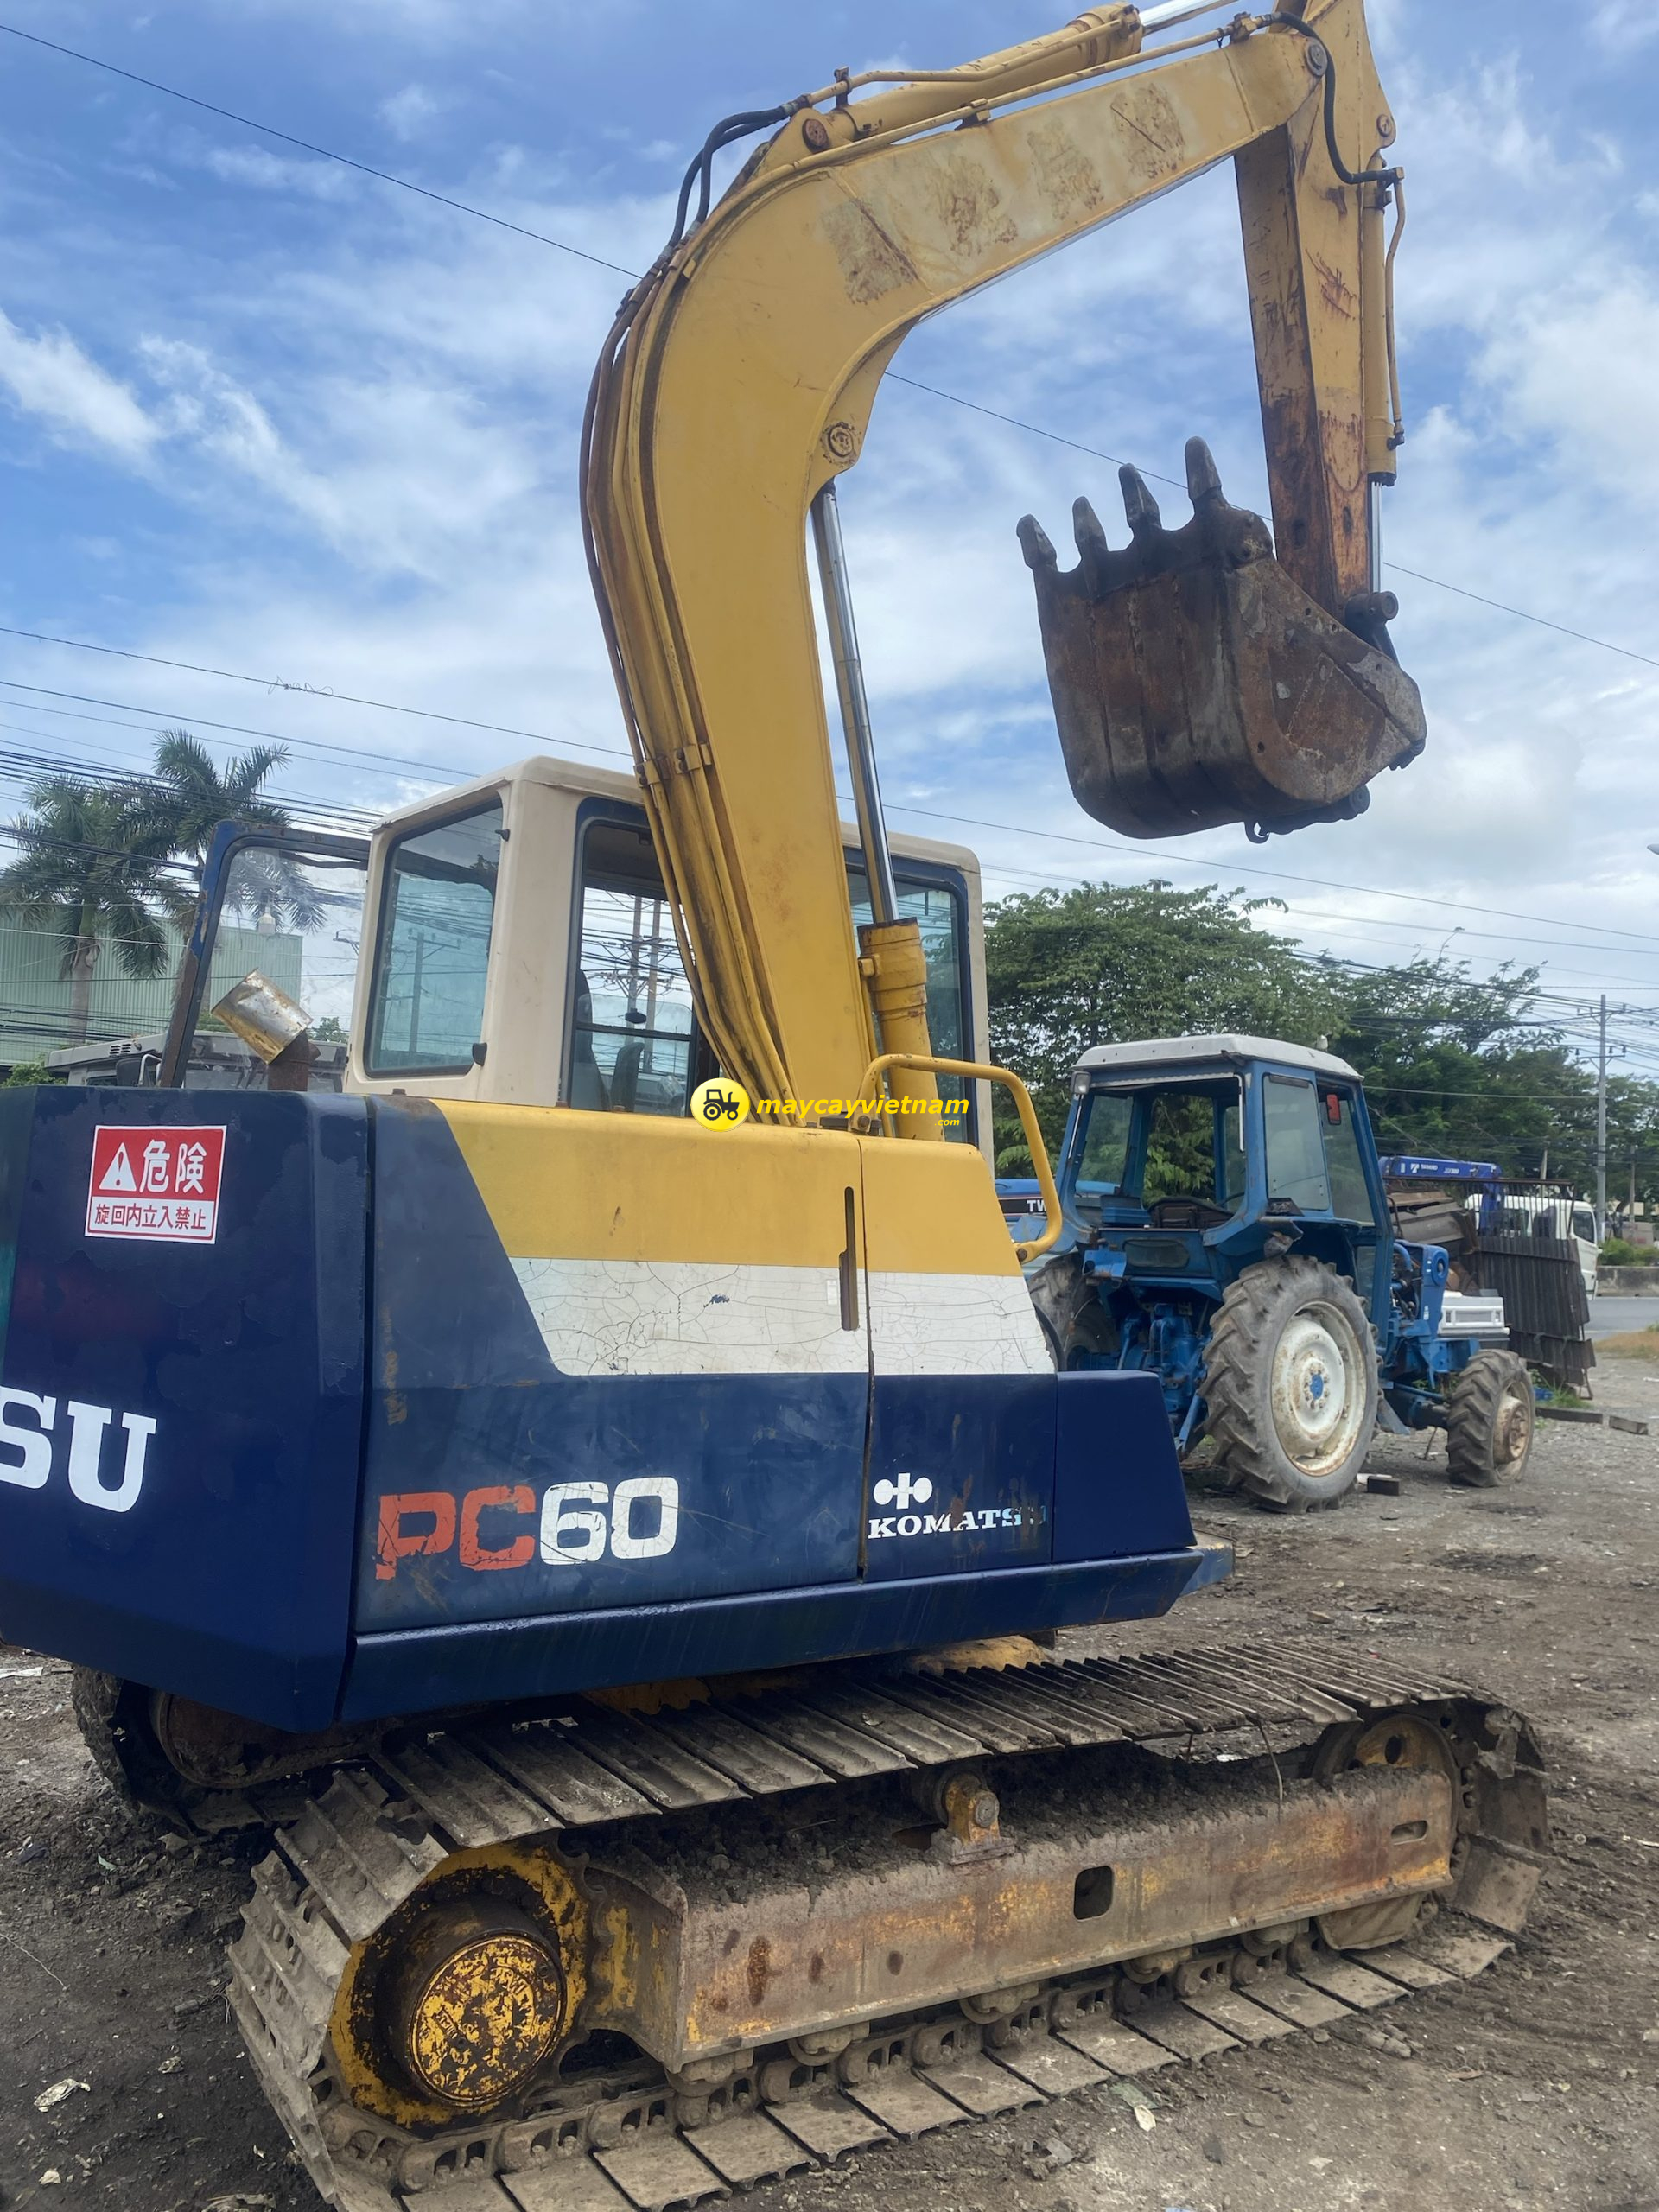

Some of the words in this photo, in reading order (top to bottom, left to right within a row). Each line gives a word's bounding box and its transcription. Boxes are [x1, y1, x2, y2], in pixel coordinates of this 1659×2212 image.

[139, 1139, 207, 1194] 危険
[94, 1203, 207, 1230] 旋回内立入禁止
[375, 1476, 679, 1580] PC60
